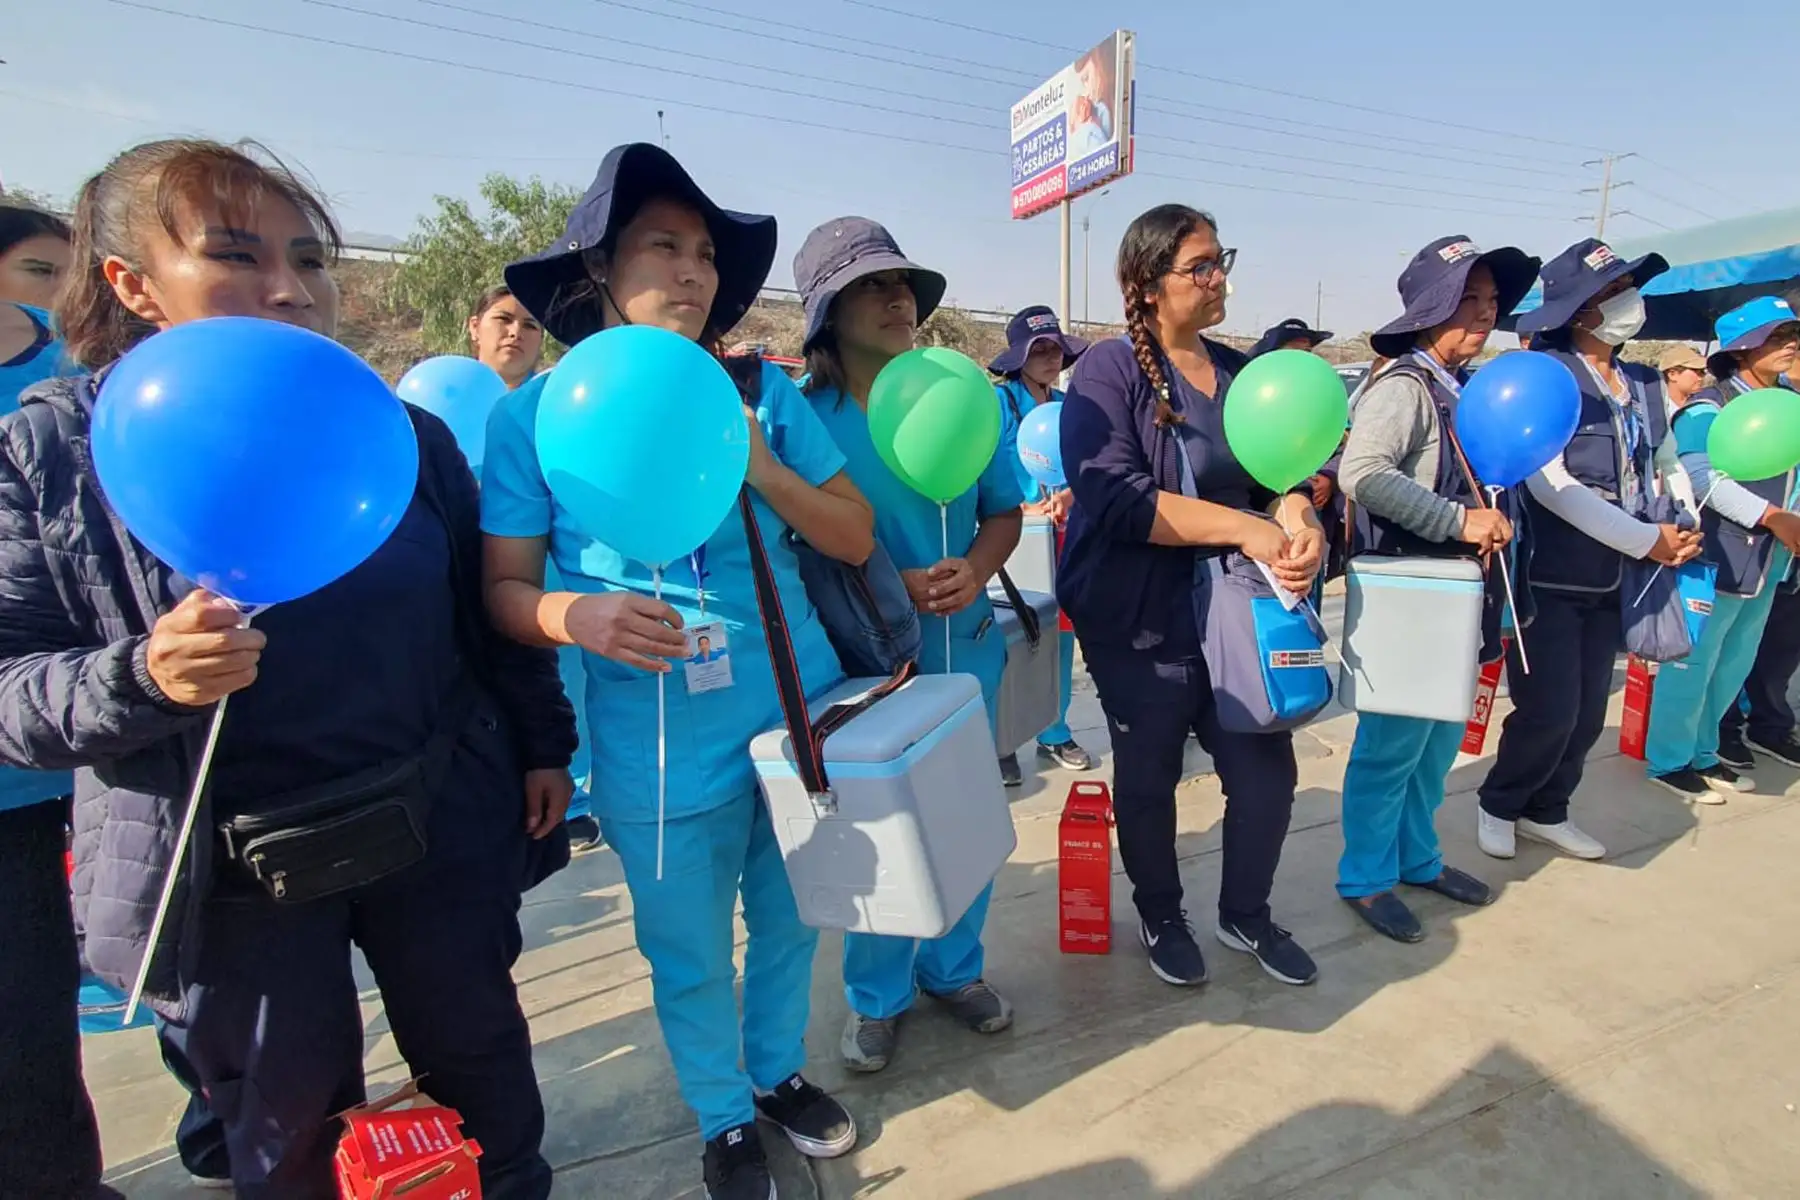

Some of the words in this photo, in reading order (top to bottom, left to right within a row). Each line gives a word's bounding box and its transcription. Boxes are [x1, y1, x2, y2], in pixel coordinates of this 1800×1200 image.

[1022, 83, 1064, 119] Monteluz
[1022, 127, 1054, 159] PARTOS
[1055, 122, 1063, 139] &
[1088, 150, 1115, 177] HORAS
